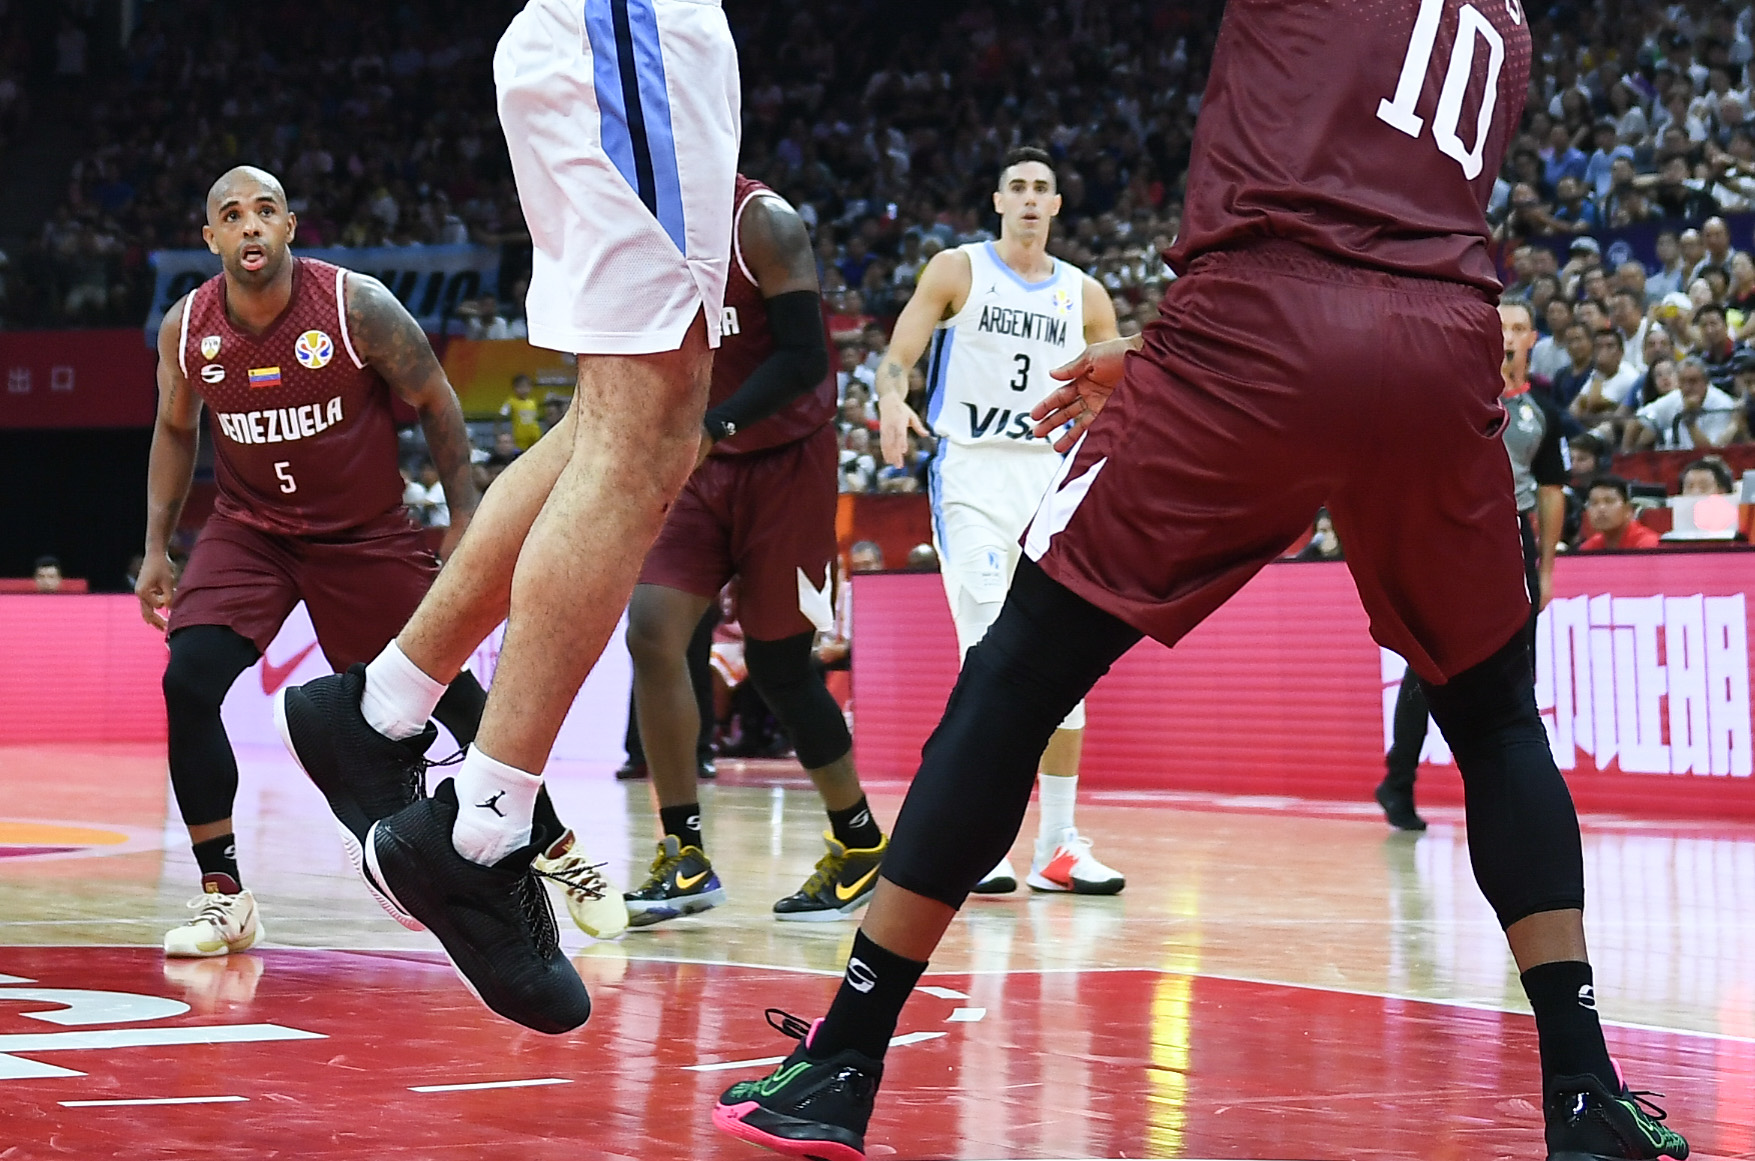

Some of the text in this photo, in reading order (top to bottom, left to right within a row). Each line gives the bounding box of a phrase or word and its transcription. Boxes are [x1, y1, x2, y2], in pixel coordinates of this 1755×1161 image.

[978, 305, 1067, 348] ARGENTINA
[1010, 353, 1030, 392] 3
[216, 396, 343, 444] VENEZUELA
[274, 461, 297, 494] 5
